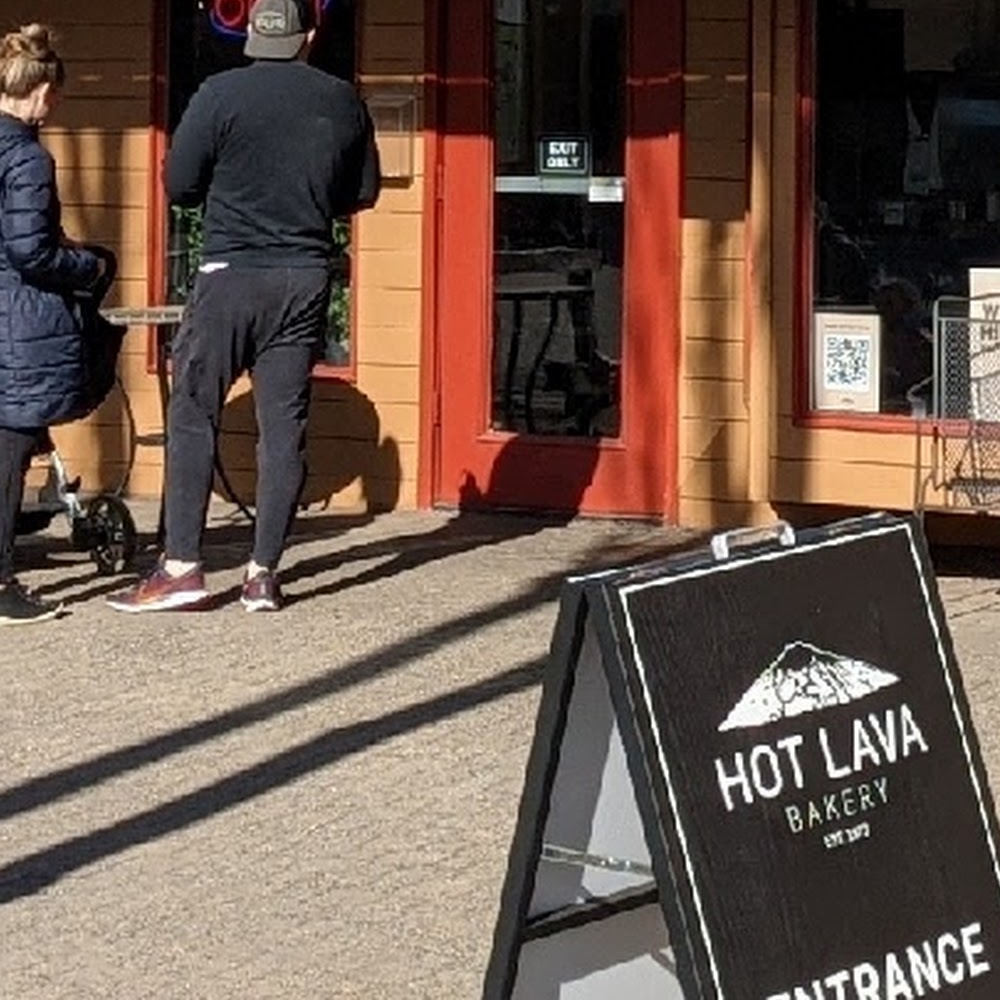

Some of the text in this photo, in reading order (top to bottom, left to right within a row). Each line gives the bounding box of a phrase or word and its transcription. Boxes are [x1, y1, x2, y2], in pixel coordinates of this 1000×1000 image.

[714, 703, 929, 812] HOT LAVA
[784, 776, 888, 833] BAKERY
